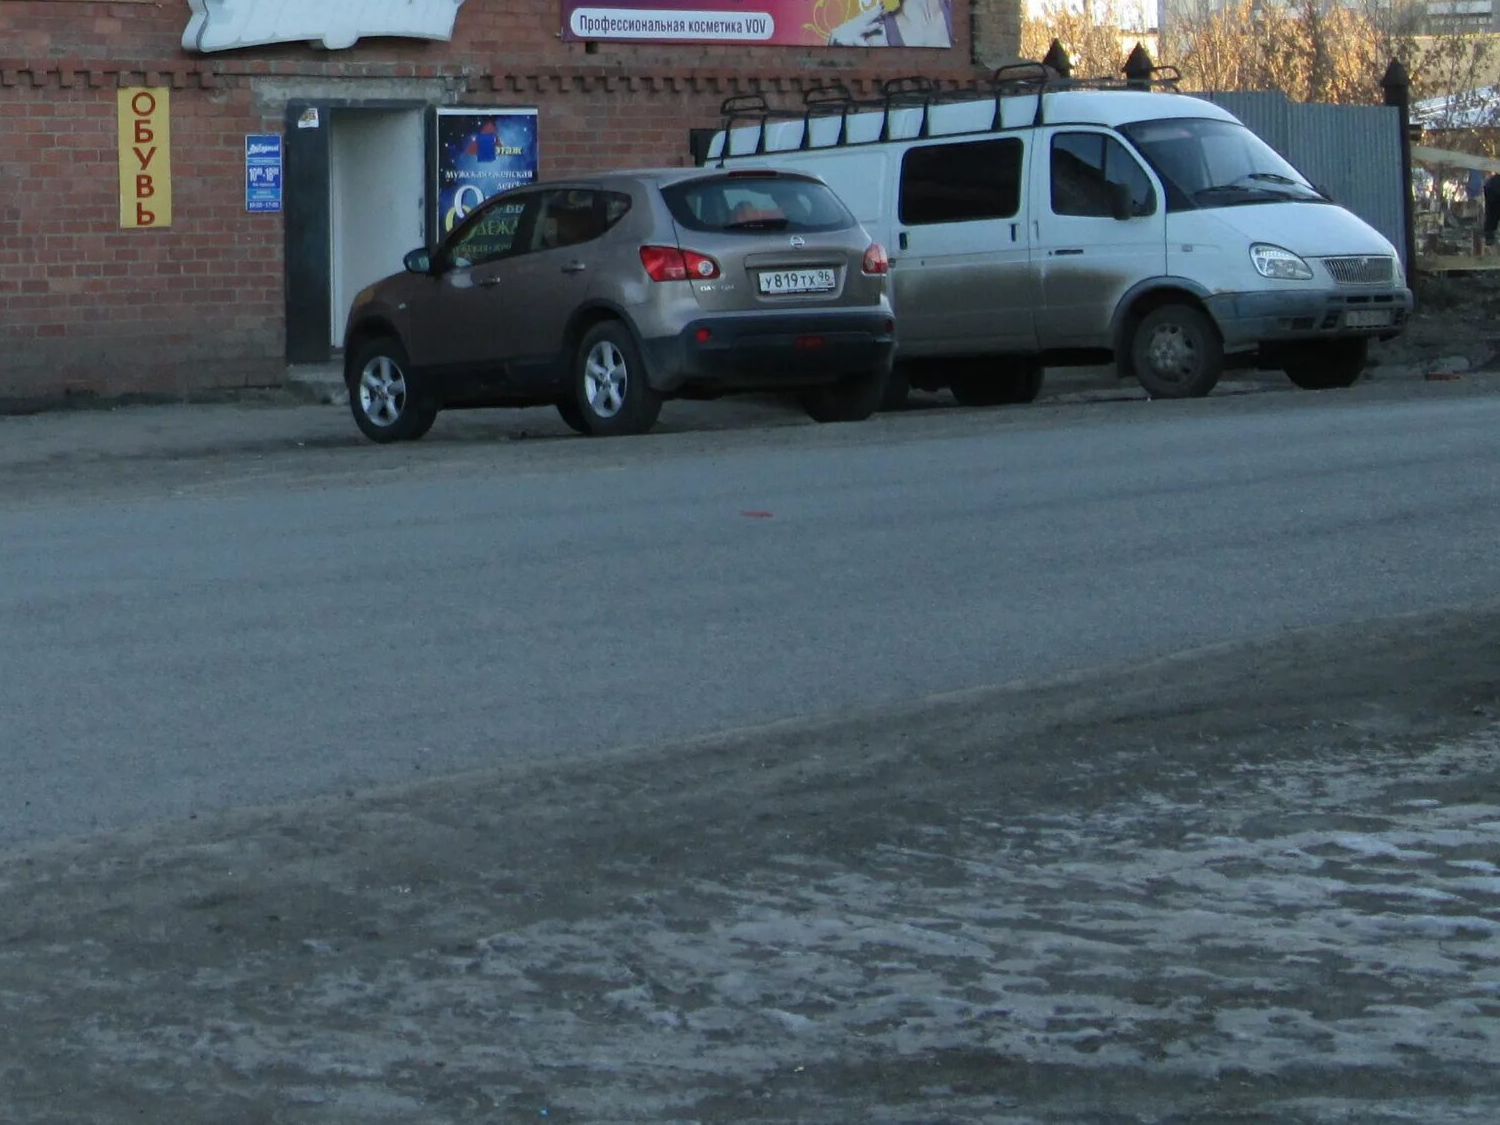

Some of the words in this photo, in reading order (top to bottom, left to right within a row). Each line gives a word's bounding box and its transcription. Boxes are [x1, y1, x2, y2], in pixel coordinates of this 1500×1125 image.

[579, 14, 685, 35] Профессиональная
[688, 18, 743, 34] косметика
[745, 18, 767, 34] VOV
[131, 91, 157, 226] ОБУВЬ
